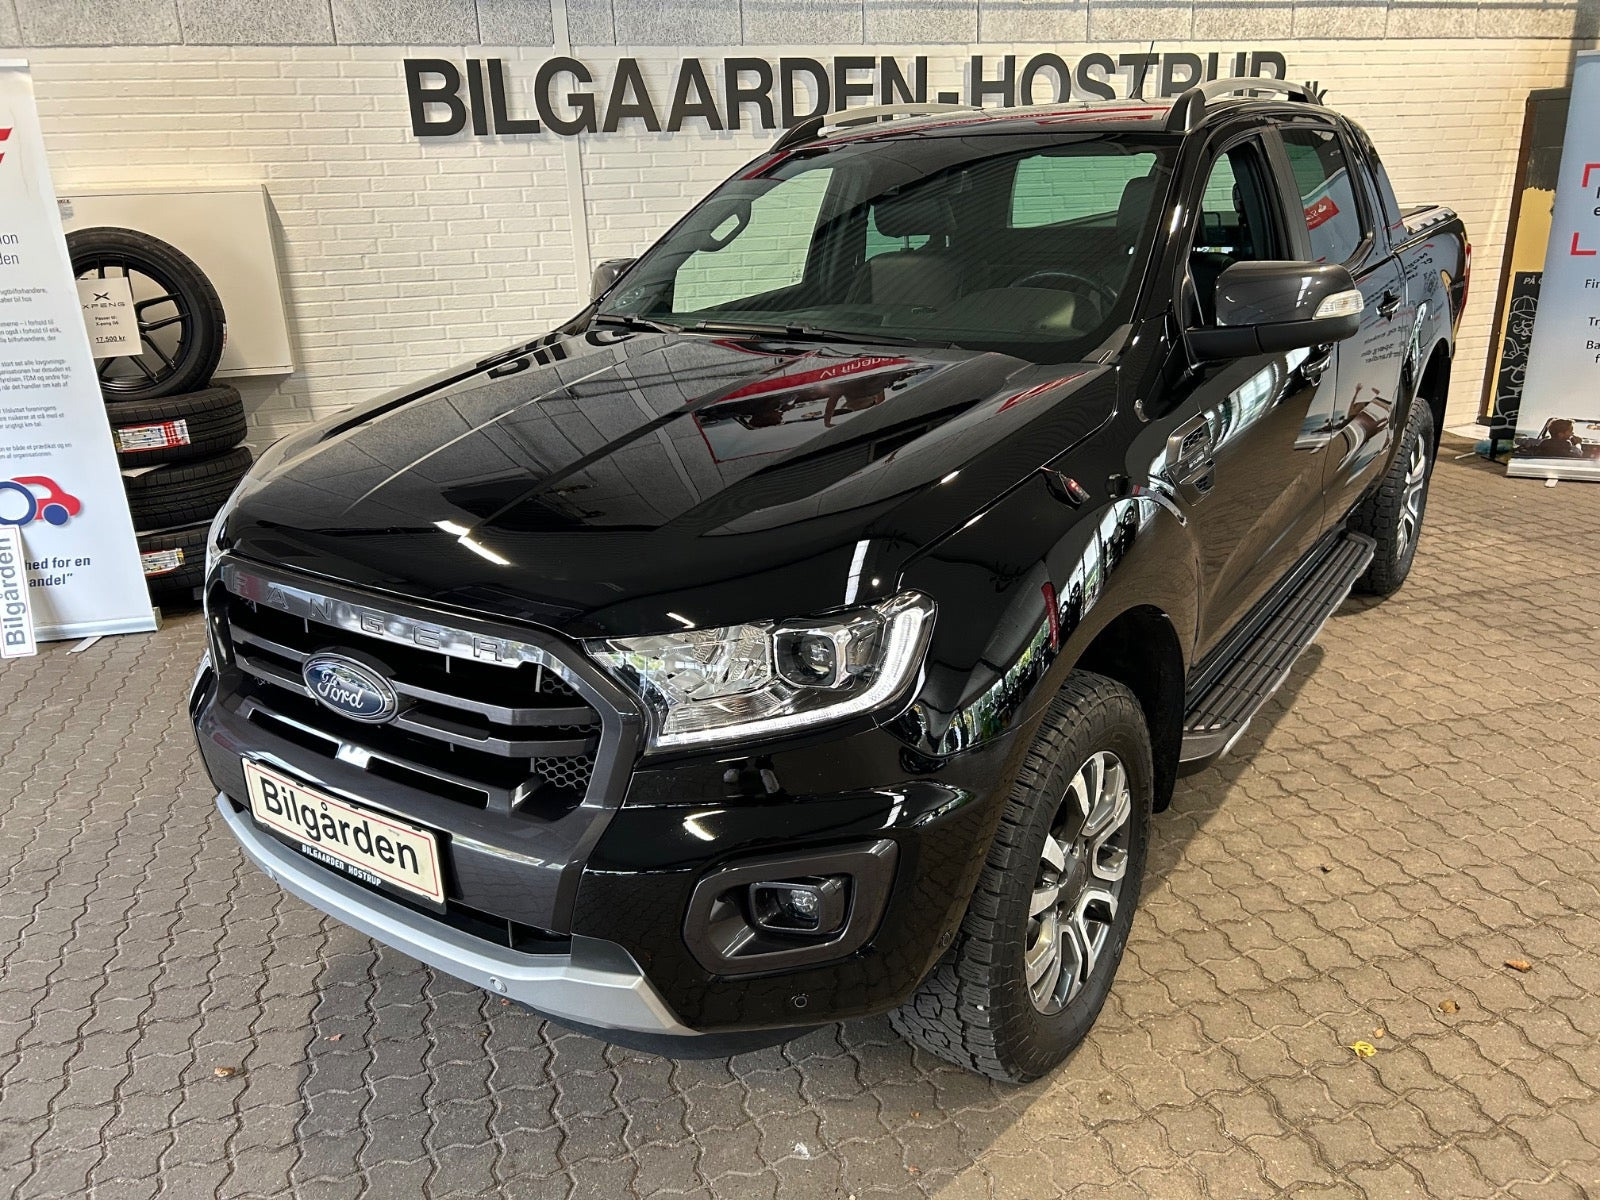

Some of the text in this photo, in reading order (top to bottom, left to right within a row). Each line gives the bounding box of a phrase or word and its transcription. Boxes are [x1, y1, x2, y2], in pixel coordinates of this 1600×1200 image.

[82, 302, 126, 310] XPENG
[52, 556, 72, 569] for
[74, 557, 91, 567] en
[0, 537, 26, 646] Bilgården
[316, 670, 365, 710] Ford
[260, 775, 420, 875] Bilgården
[301, 844, 382, 887] BILGAARDEN HOSTRUP
